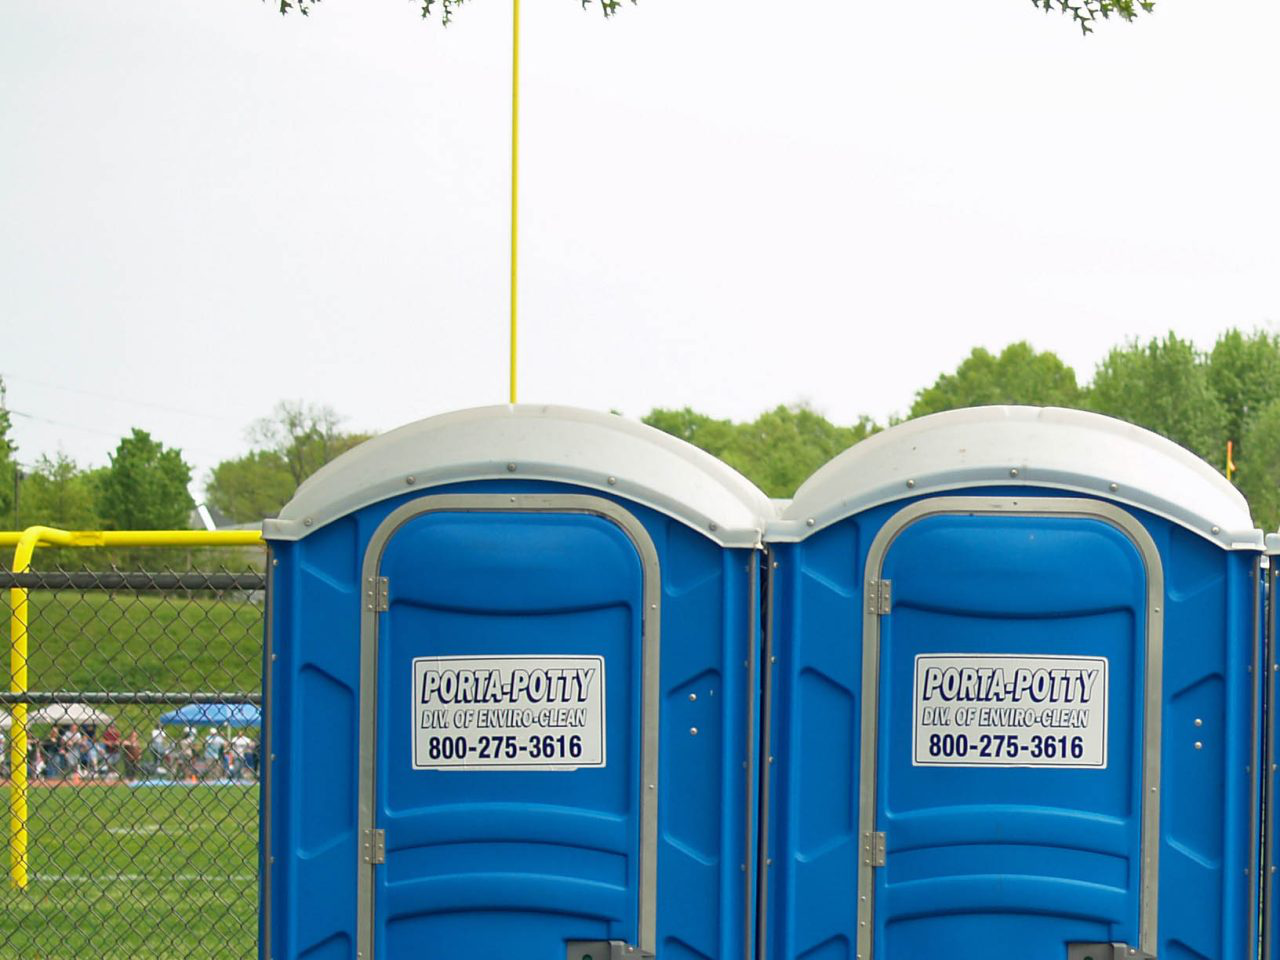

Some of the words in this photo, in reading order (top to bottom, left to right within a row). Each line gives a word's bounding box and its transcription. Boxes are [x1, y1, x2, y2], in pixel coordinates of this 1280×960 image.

[421, 668, 596, 704] PORTA-POTTY
[923, 667, 1099, 703] PORTA-POTTY
[421, 709, 449, 728] DIV.
[454, 709, 475, 728] OF
[477, 708, 587, 728] ENVIRO-CLEAN
[922, 707, 950, 726] DIV.
[955, 707, 977, 727] OF
[978, 707, 1090, 728] ENVIRO-CLEAN
[428, 735, 582, 759] 800-275-3616
[929, 734, 1084, 758] 800-275-3616
